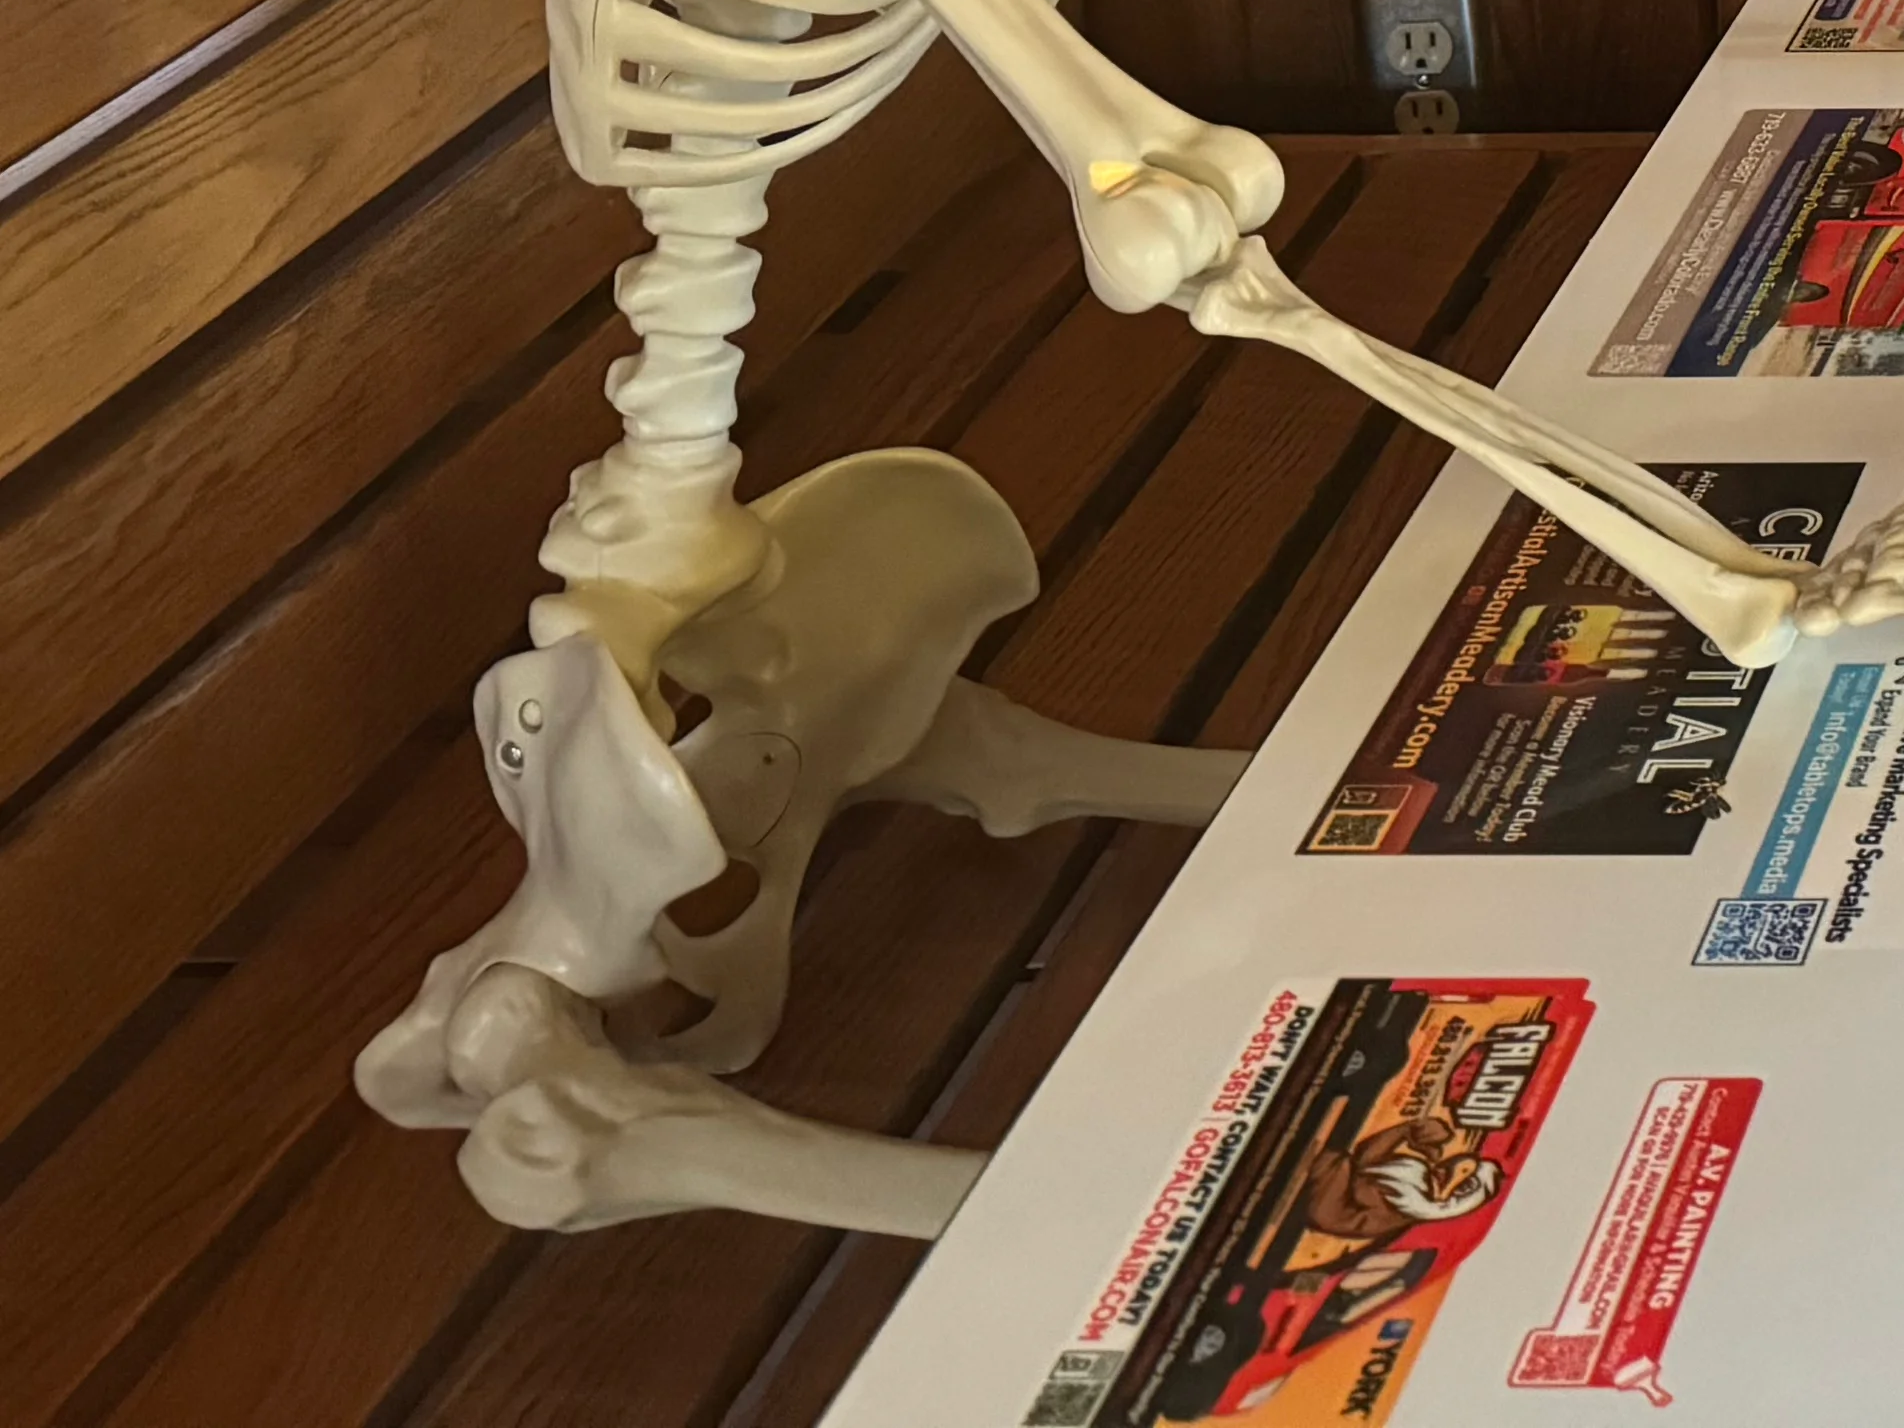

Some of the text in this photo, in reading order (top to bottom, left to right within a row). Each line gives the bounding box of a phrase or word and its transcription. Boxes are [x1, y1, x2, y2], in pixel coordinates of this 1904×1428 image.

[1637, 189, 1734, 340] www.ClearlyColorado.com
[1716, 172, 1833, 366] Locally Owned Serving Entire Range
[1444, 759, 1485, 822] information
[1467, 719, 1530, 816] Scan below
[1502, 696, 1595, 841] Visionary Mead Club
[1845, 688, 1901, 787] Expand Your Brand
[1758, 711, 1852, 893] info@tabletops.media
[1825, 848, 1882, 942] Specialists
[1213, 990, 1296, 1111] 480-813-3613
[1457, 1024, 1548, 1126] FALCON
[1119, 1005, 1313, 1324] DON'T WAIT, CONTACT US TODAY!
[1579, 1106, 1669, 1303] SCAN INFORMATION
[1697, 1143, 1729, 1184] A.V.
[1082, 1128, 1218, 1340] GOFALCONAIR.COM
[1650, 1191, 1712, 1308] PAINTING
[1342, 1343, 1401, 1414] YORK
